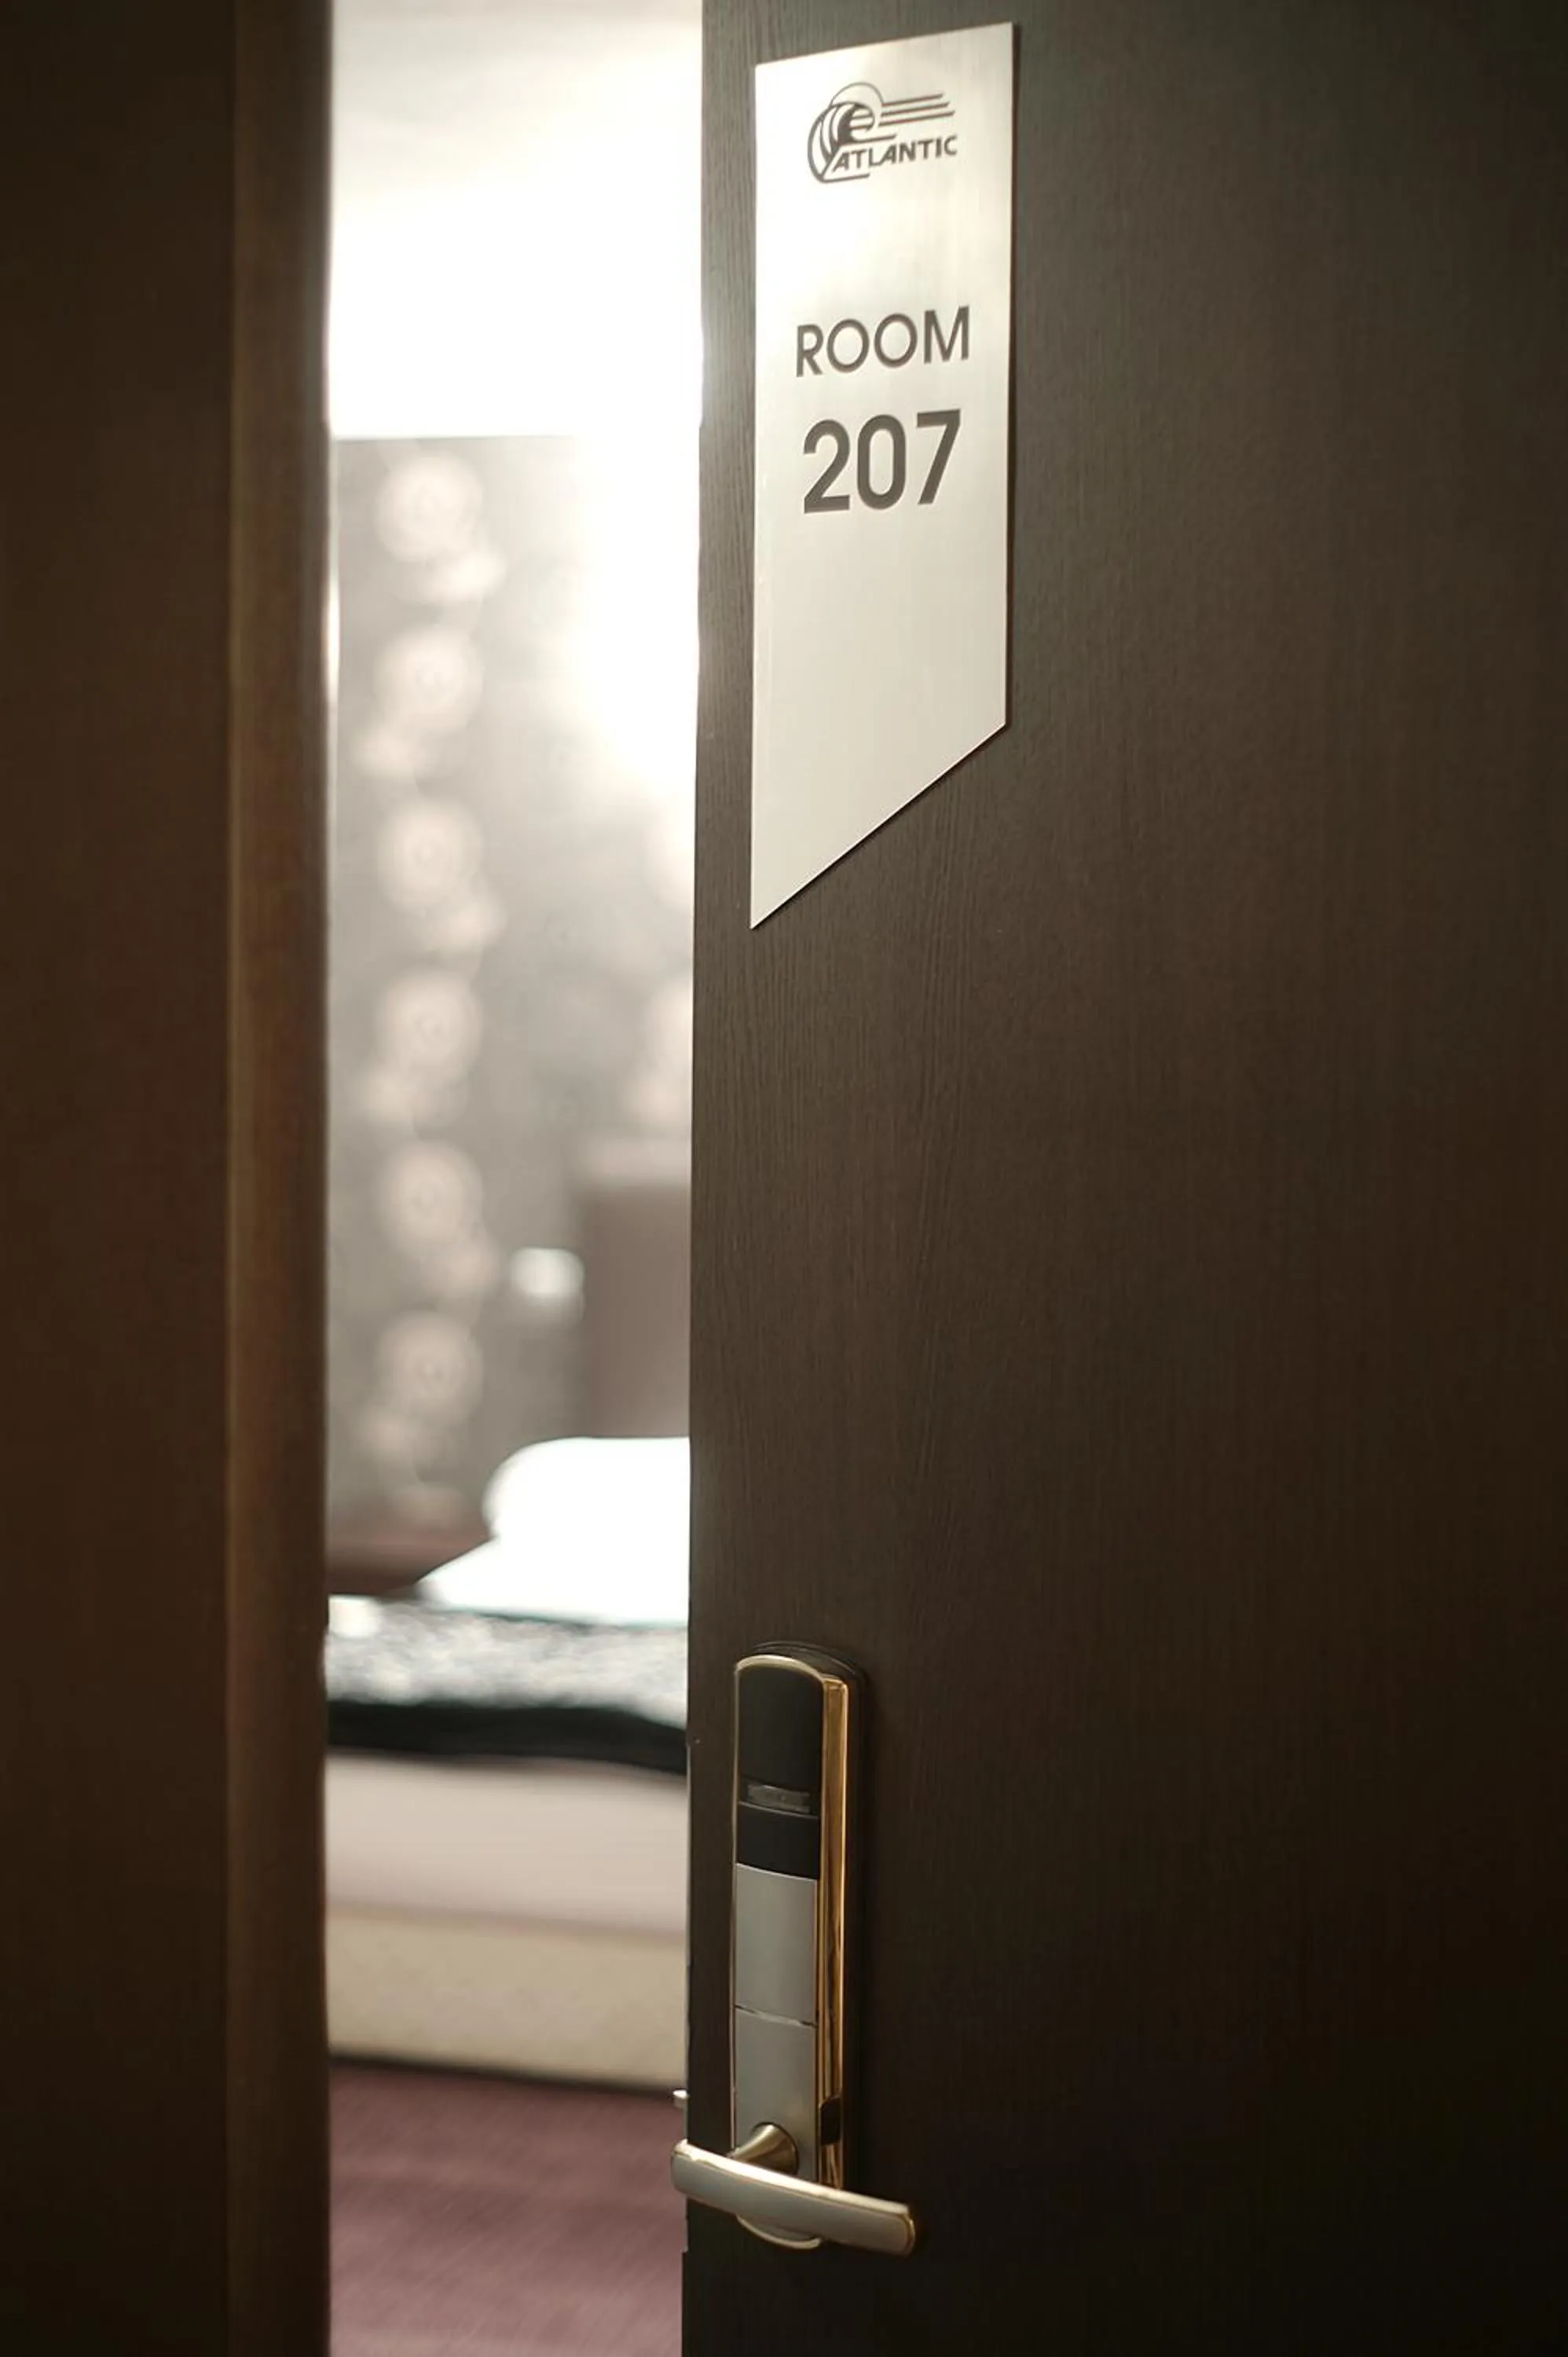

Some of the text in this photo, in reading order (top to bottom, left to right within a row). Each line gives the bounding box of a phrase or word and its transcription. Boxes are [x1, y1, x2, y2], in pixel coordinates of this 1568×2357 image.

[831, 134, 958, 173] ATLANTIC
[795, 305, 971, 379] ROOM
[803, 408, 962, 515] 207
